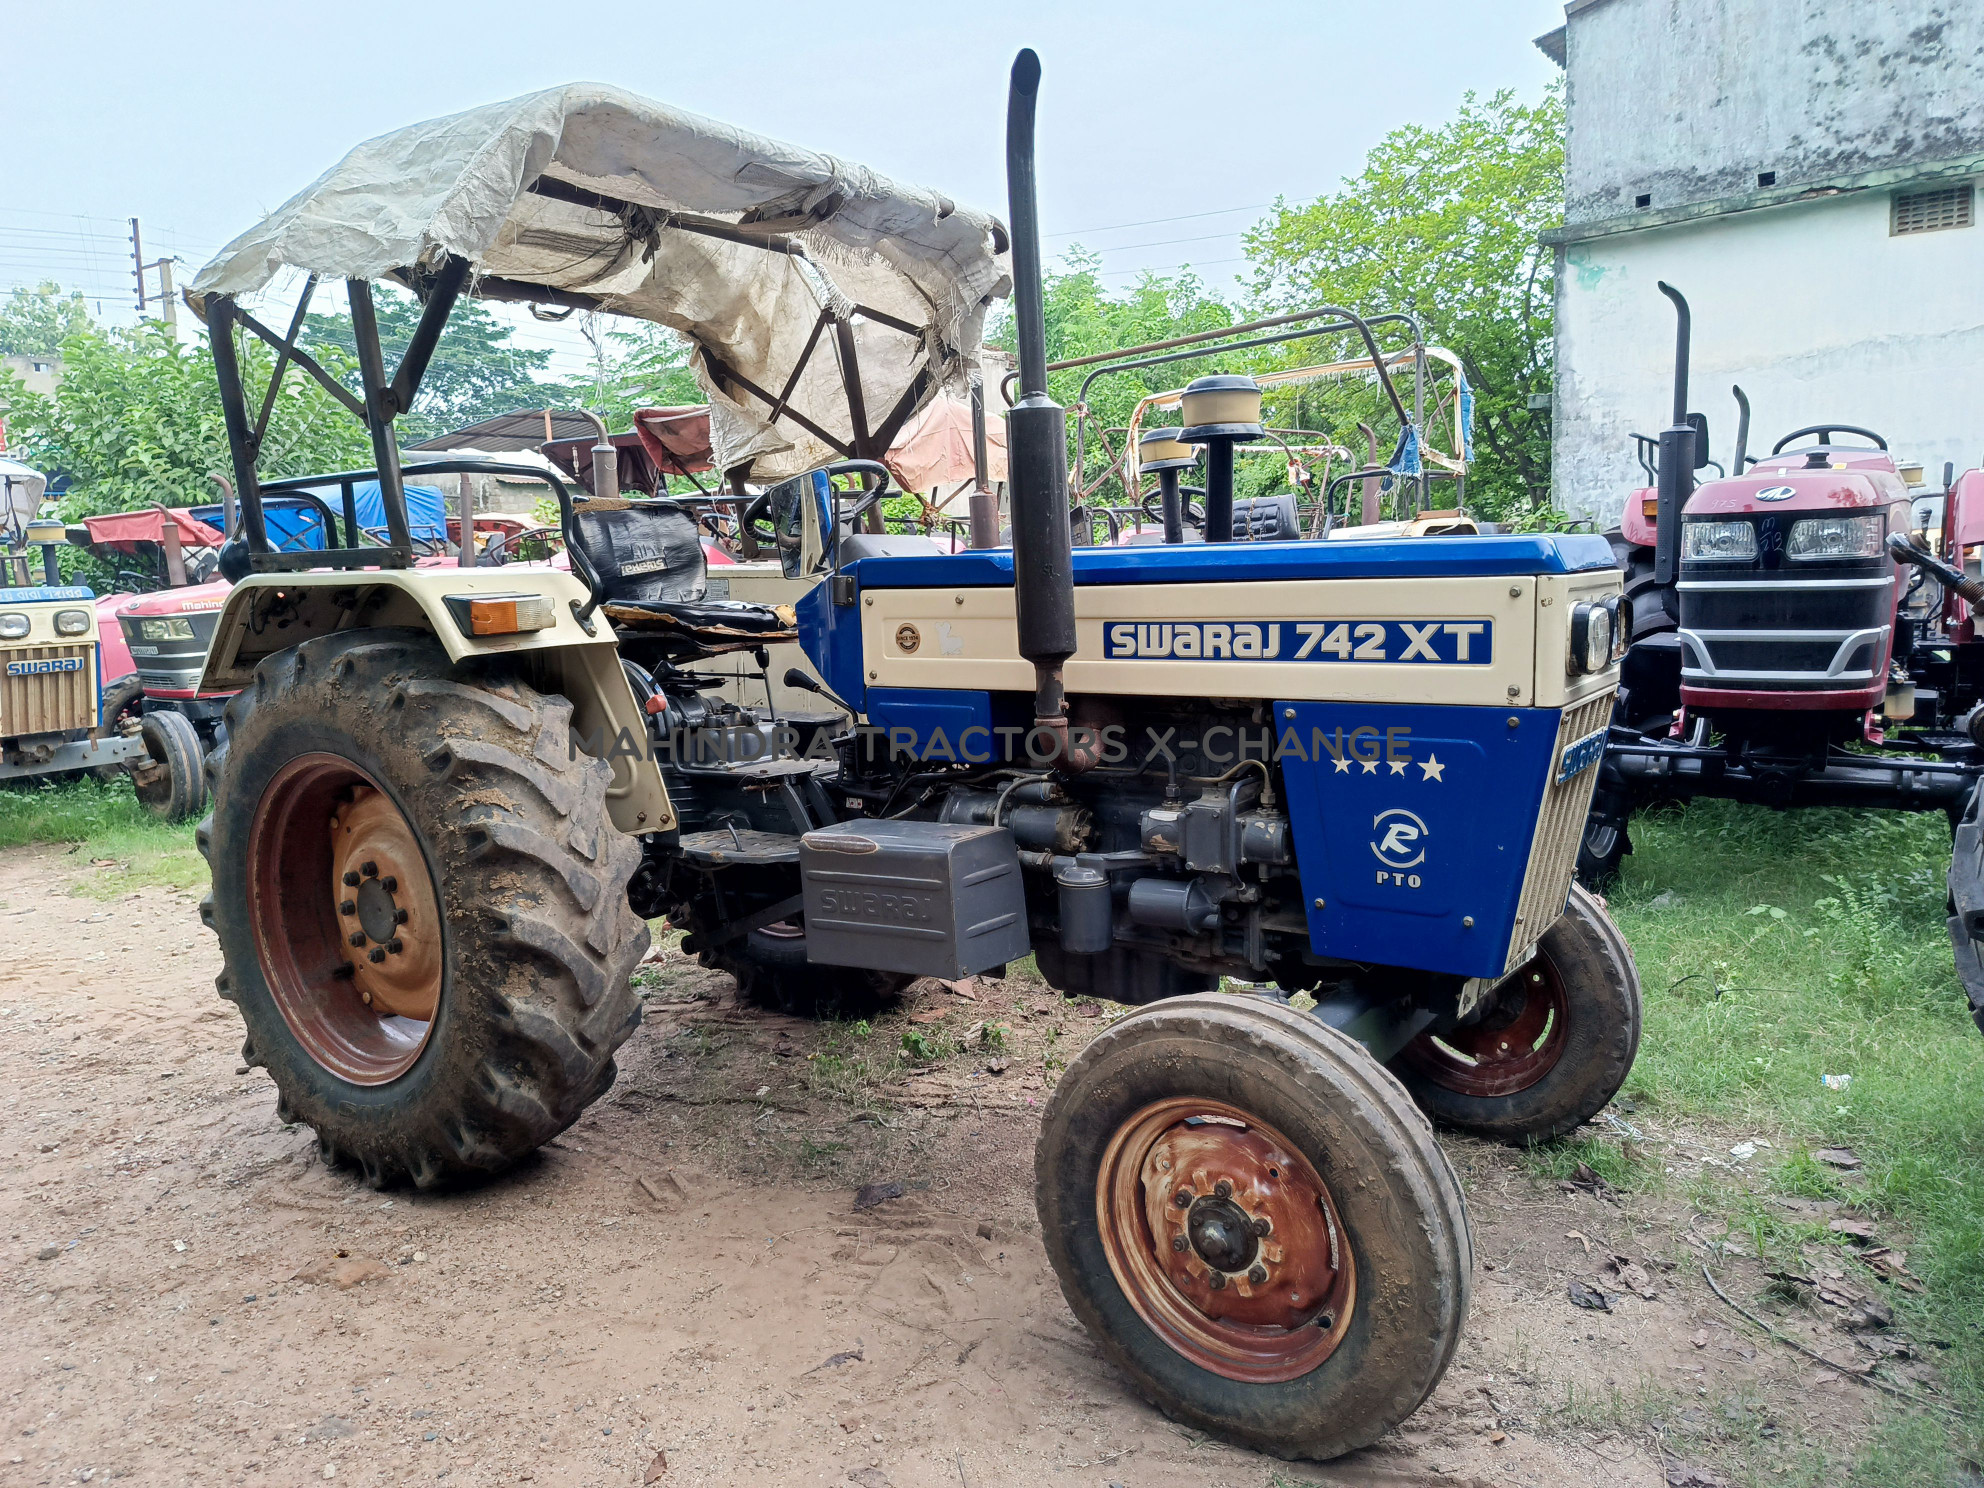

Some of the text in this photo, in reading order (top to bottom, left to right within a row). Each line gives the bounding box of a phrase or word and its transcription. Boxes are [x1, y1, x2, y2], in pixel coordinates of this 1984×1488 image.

[1293, 623, 1387, 660] 742
[1397, 623, 1485, 661] XT
[1376, 870, 1421, 888] PTO
